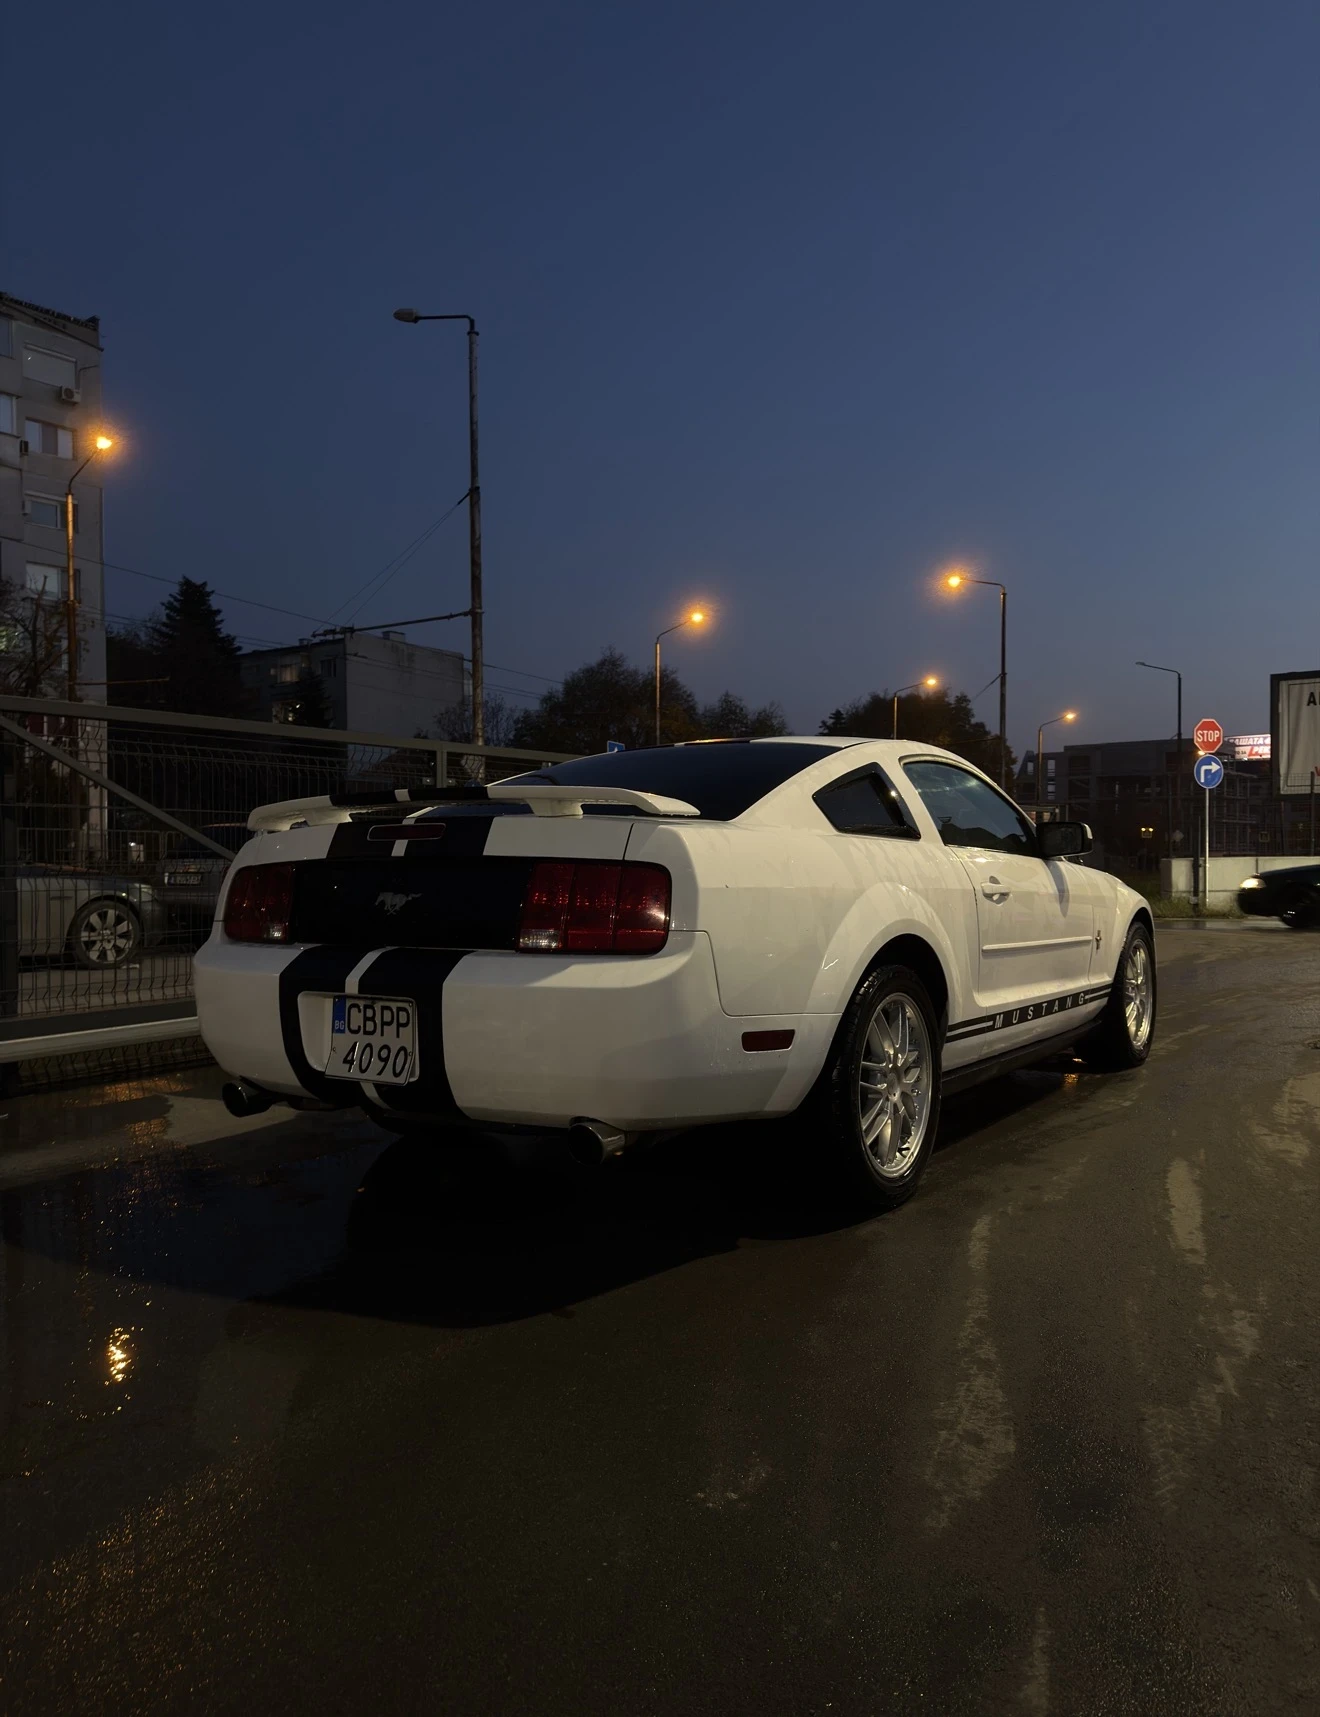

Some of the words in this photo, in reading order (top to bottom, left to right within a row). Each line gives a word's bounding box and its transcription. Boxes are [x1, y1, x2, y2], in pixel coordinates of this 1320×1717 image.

[1197, 730, 1220, 742] STOP
[334, 1020, 345, 1030] BG
[347, 1003, 411, 1038] CBPP
[994, 992, 1086, 1029] MUSTANG
[342, 1041, 408, 1078] 4090
